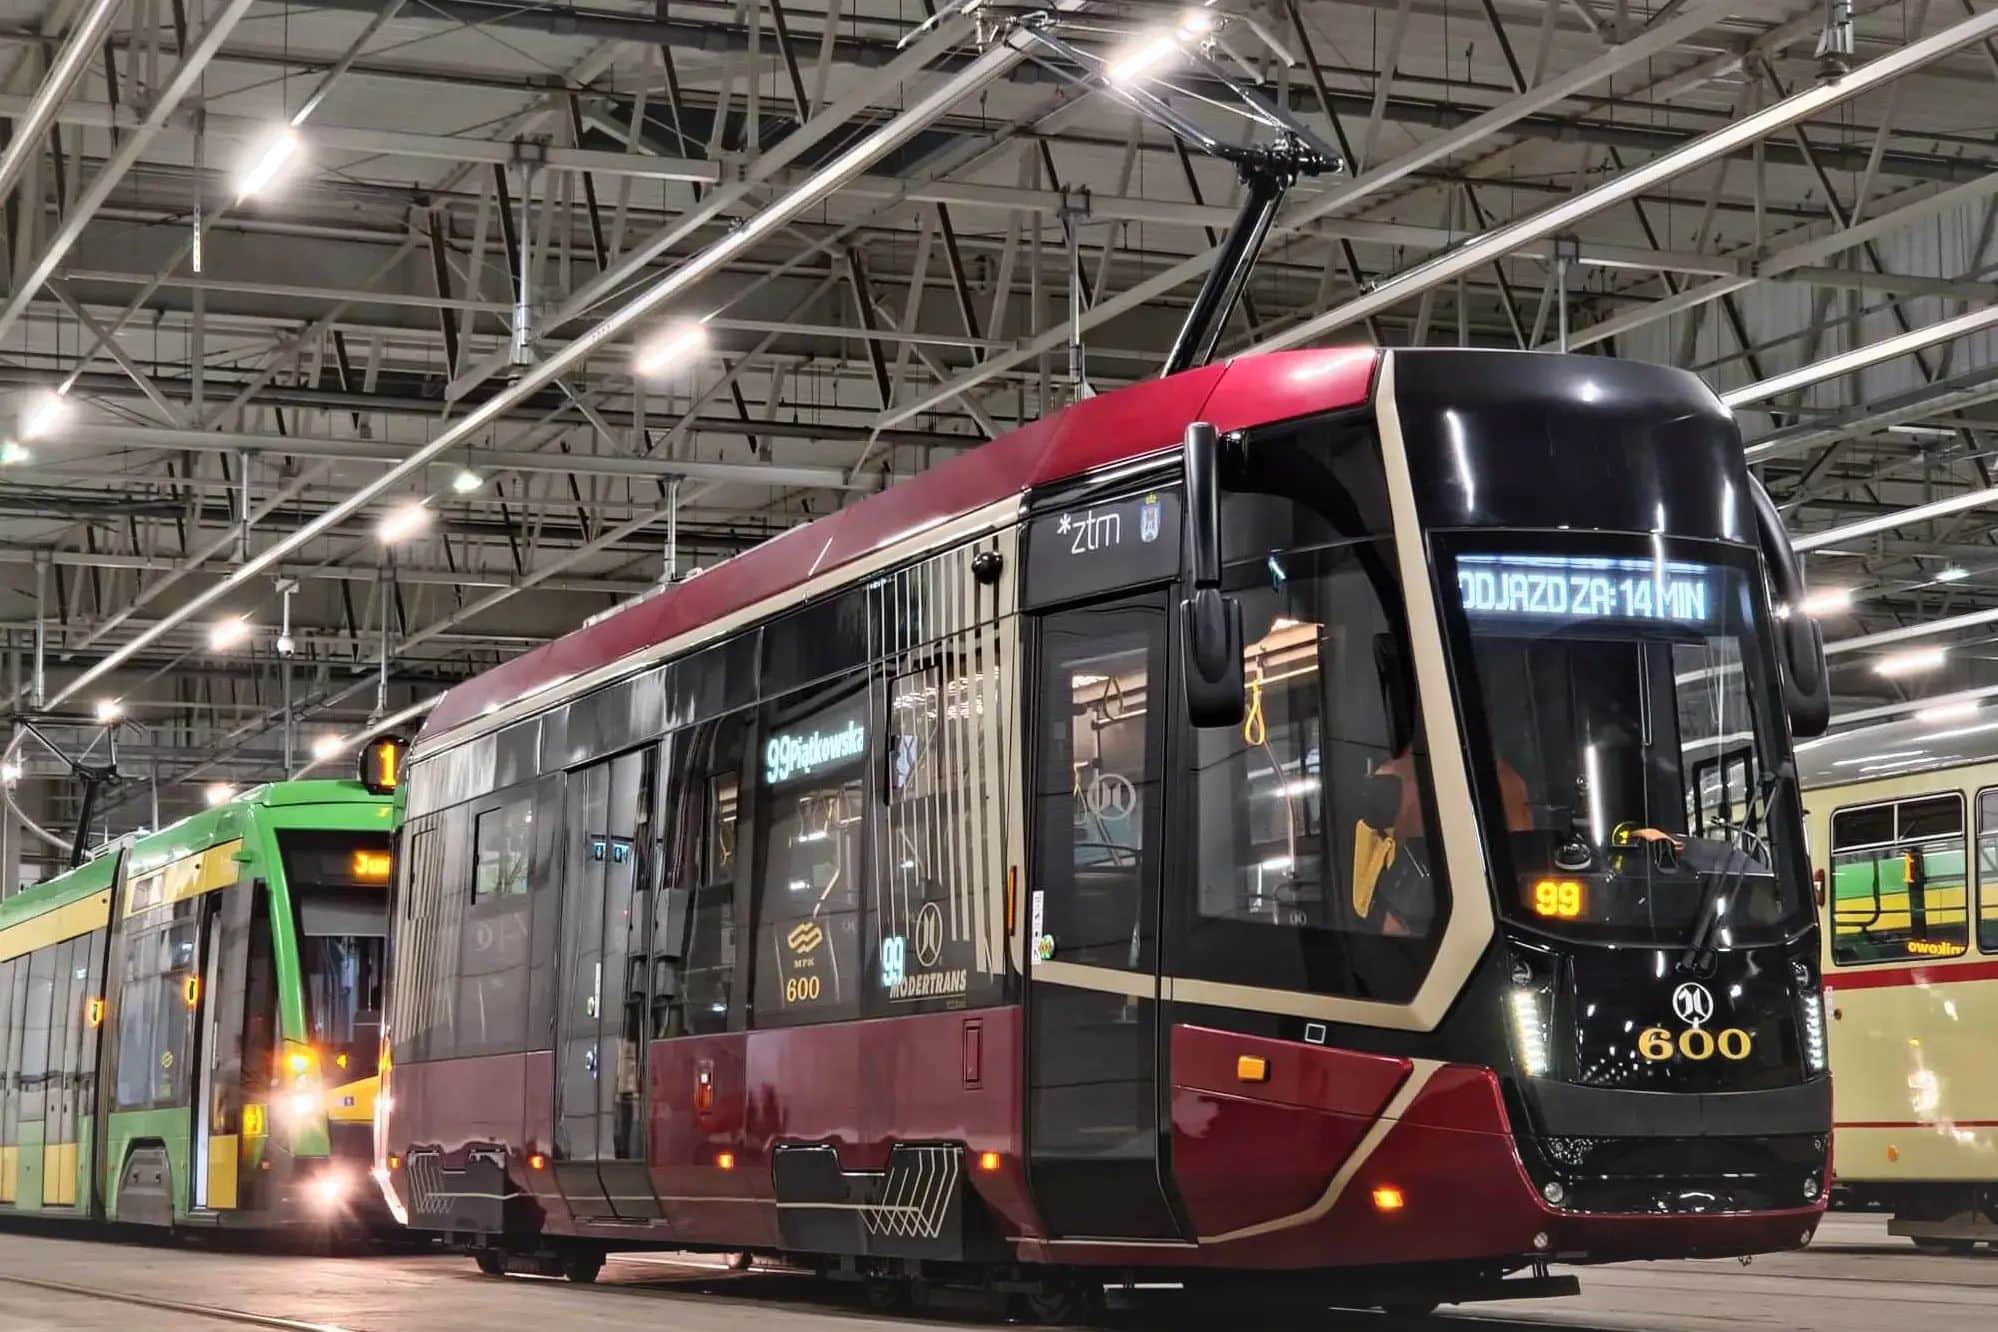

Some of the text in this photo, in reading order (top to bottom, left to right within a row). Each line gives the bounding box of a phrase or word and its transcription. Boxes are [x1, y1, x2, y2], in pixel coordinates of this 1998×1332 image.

[1459, 572, 1706, 620] ODJAZD ZA: 14 MIN
[767, 735, 790, 784] 99
[1536, 882, 1580, 916] 99
[882, 936, 904, 986] 99
[786, 975, 820, 1003] 600
[889, 969, 967, 999] MODERTRANS
[1638, 1027, 1752, 1060] 600
